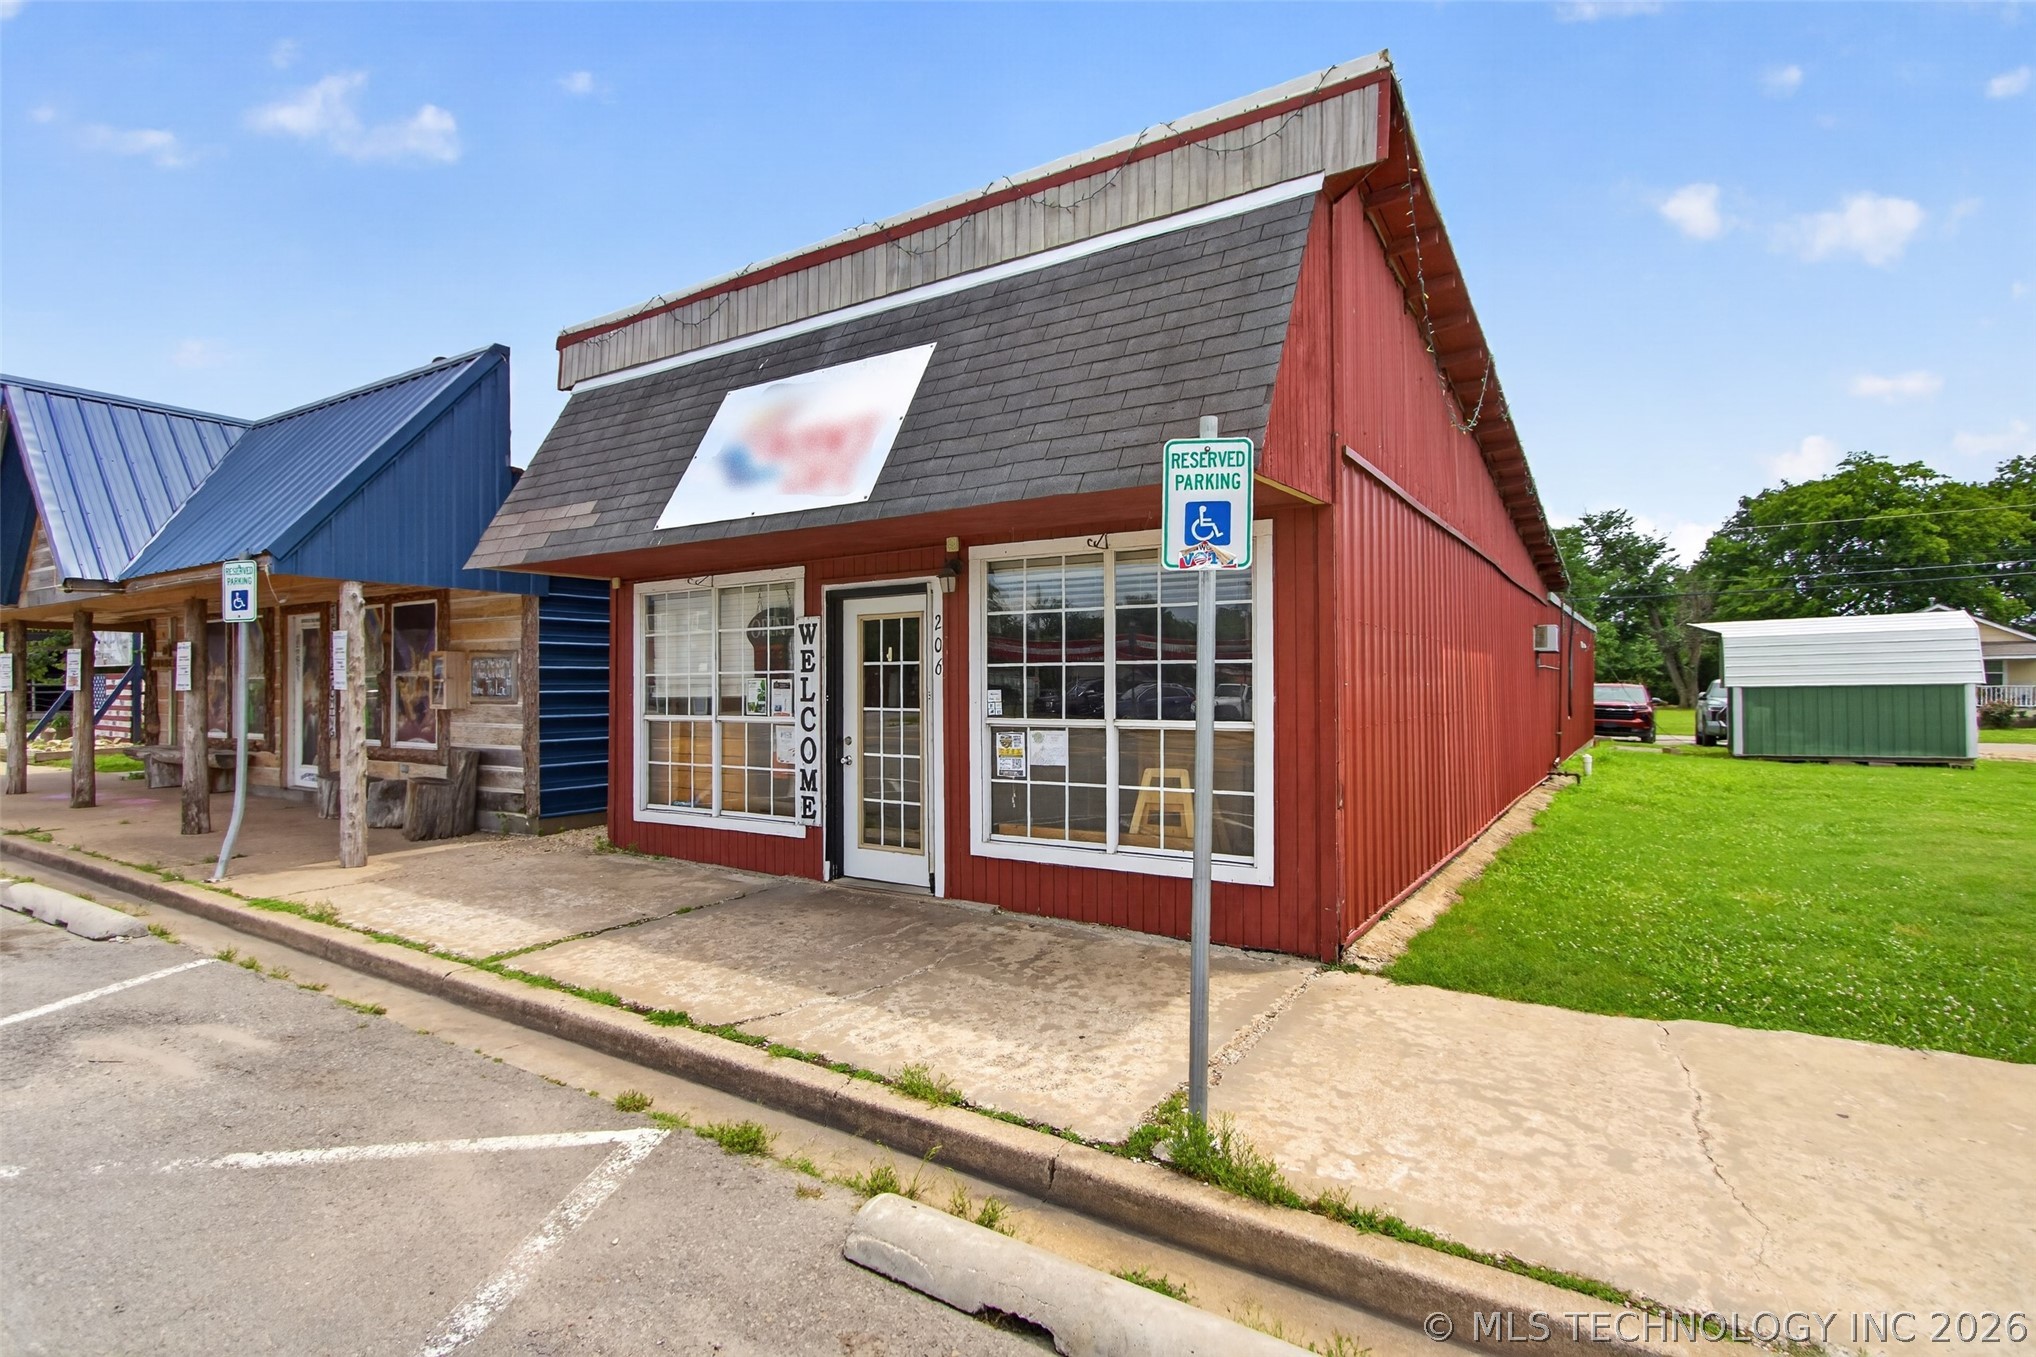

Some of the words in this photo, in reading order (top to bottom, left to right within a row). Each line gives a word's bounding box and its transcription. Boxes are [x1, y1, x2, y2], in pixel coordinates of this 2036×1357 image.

[1171, 451, 1245, 469] RESERVED
[1175, 473, 1241, 491] PARKING
[225, 566, 254, 575] RESERVED
[226, 577, 253, 585] PARKING
[934, 614, 943, 676] 206
[798, 623, 818, 820] WELCOME
